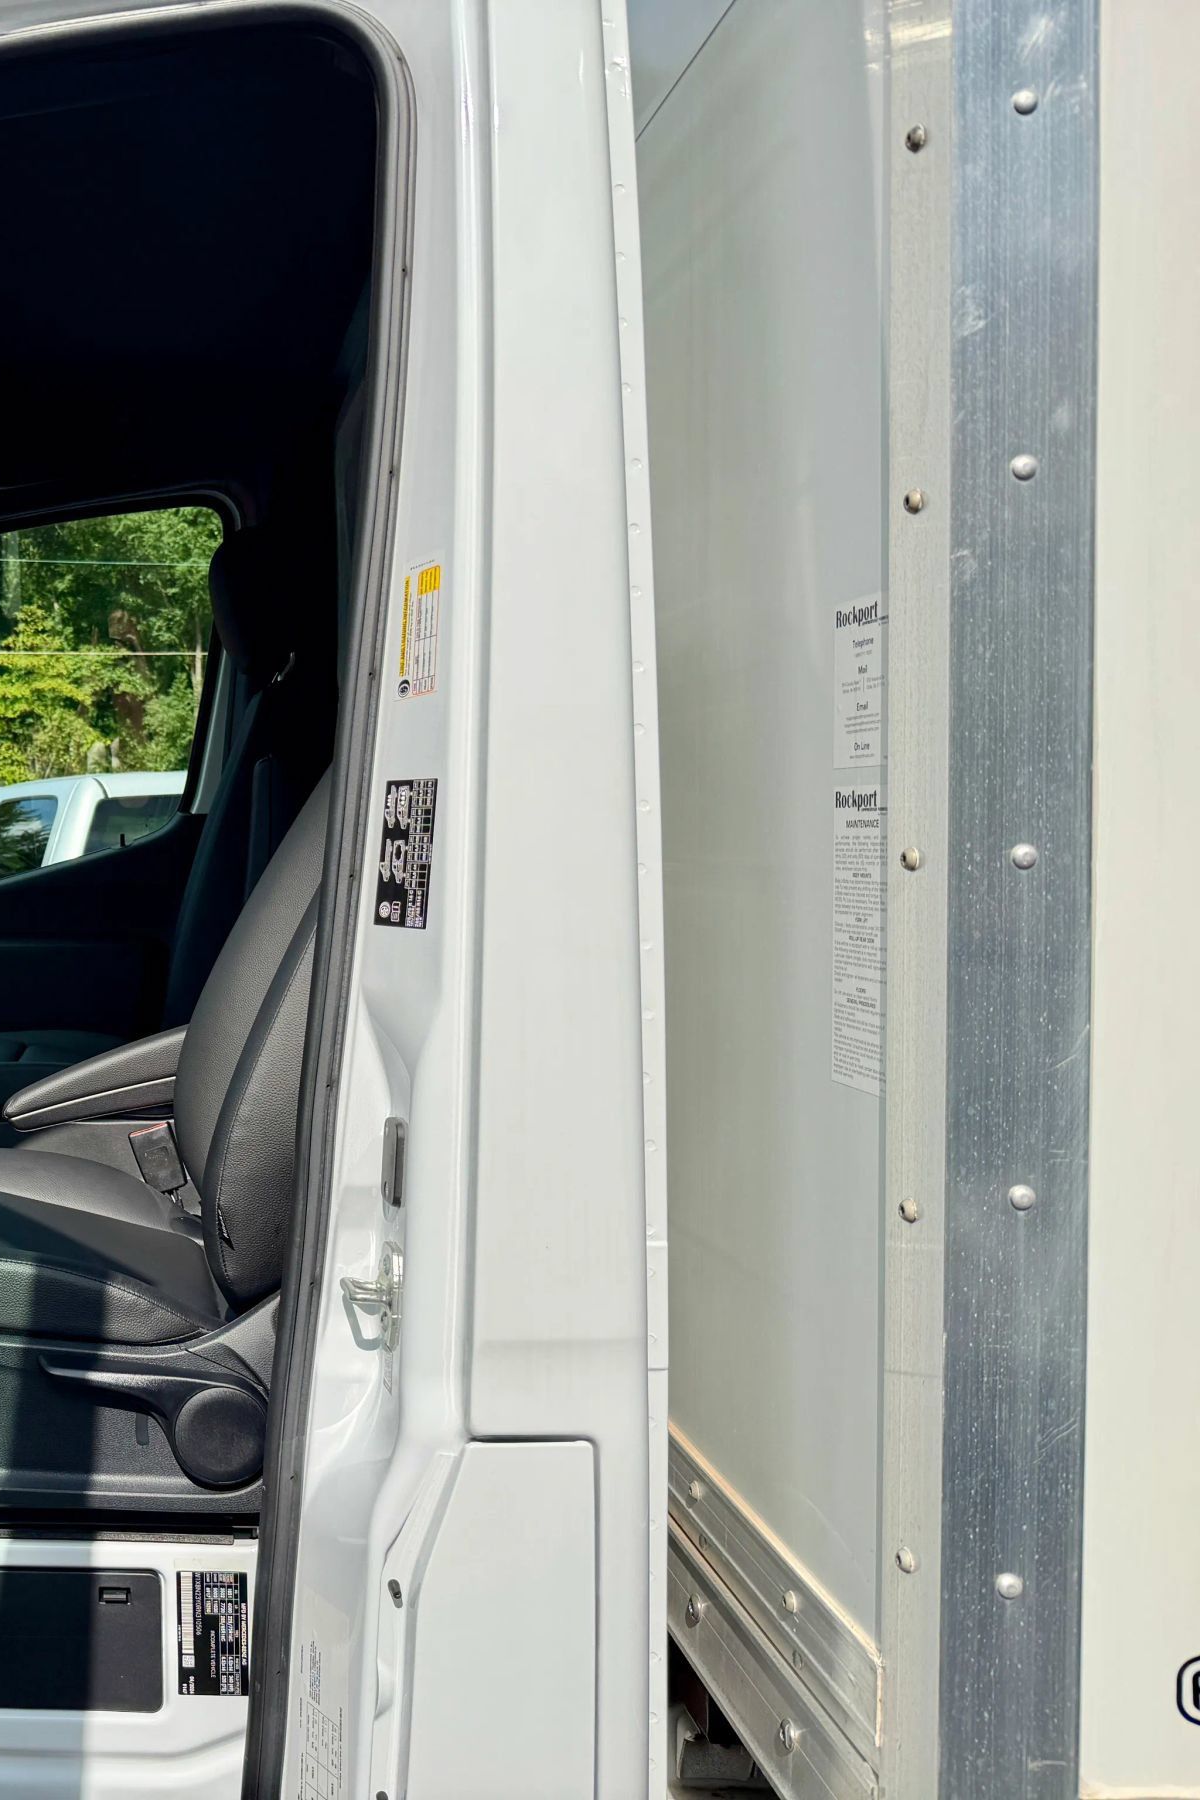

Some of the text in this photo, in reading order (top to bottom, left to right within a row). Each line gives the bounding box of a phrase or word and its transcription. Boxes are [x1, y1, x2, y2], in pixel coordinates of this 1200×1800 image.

[836, 600, 878, 629] Rockport
[858, 664, 868, 675] Mail
[856, 701, 869, 712] Email
[853, 741, 870, 751] On Line
[835, 790, 877, 812] Rockport
[846, 819, 880, 829] MAINTENANCE
